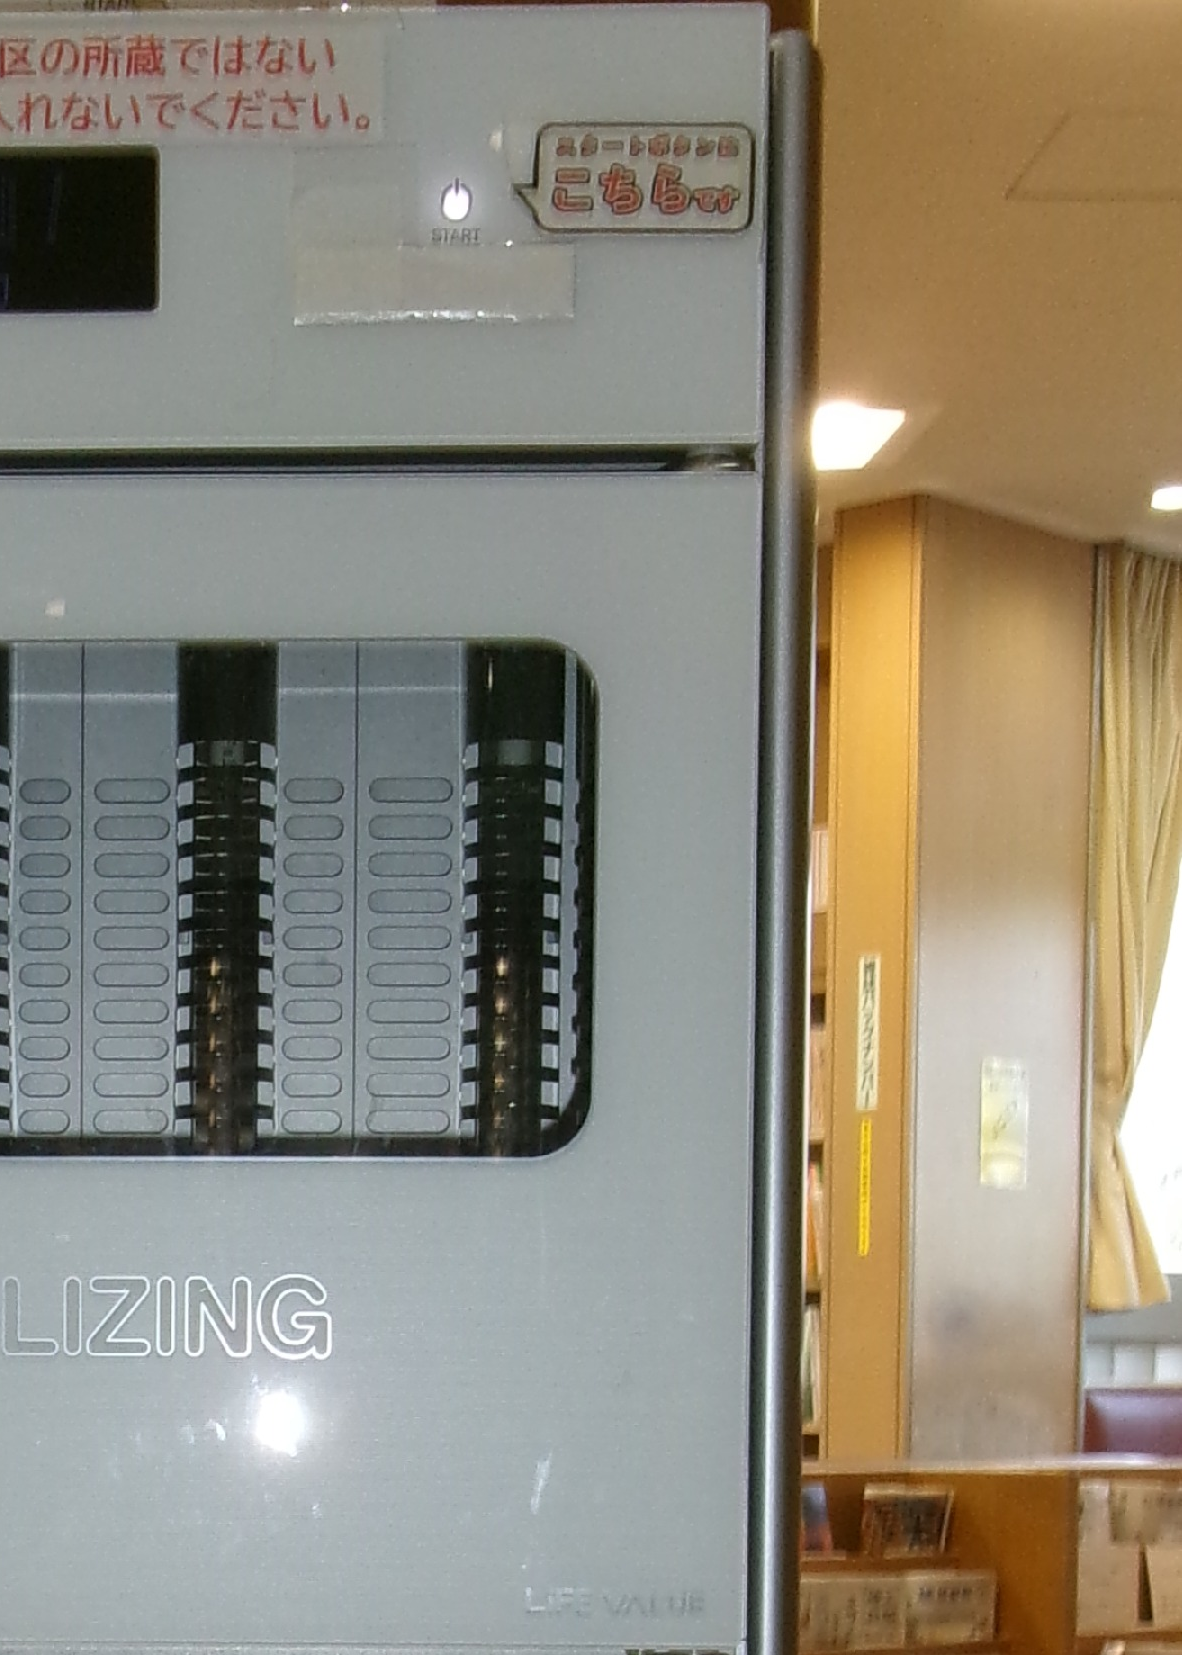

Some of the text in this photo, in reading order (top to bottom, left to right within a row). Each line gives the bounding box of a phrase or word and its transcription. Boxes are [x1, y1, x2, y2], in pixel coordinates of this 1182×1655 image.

[551, 162, 740, 214] こちらです
[431, 227, 481, 246] START
